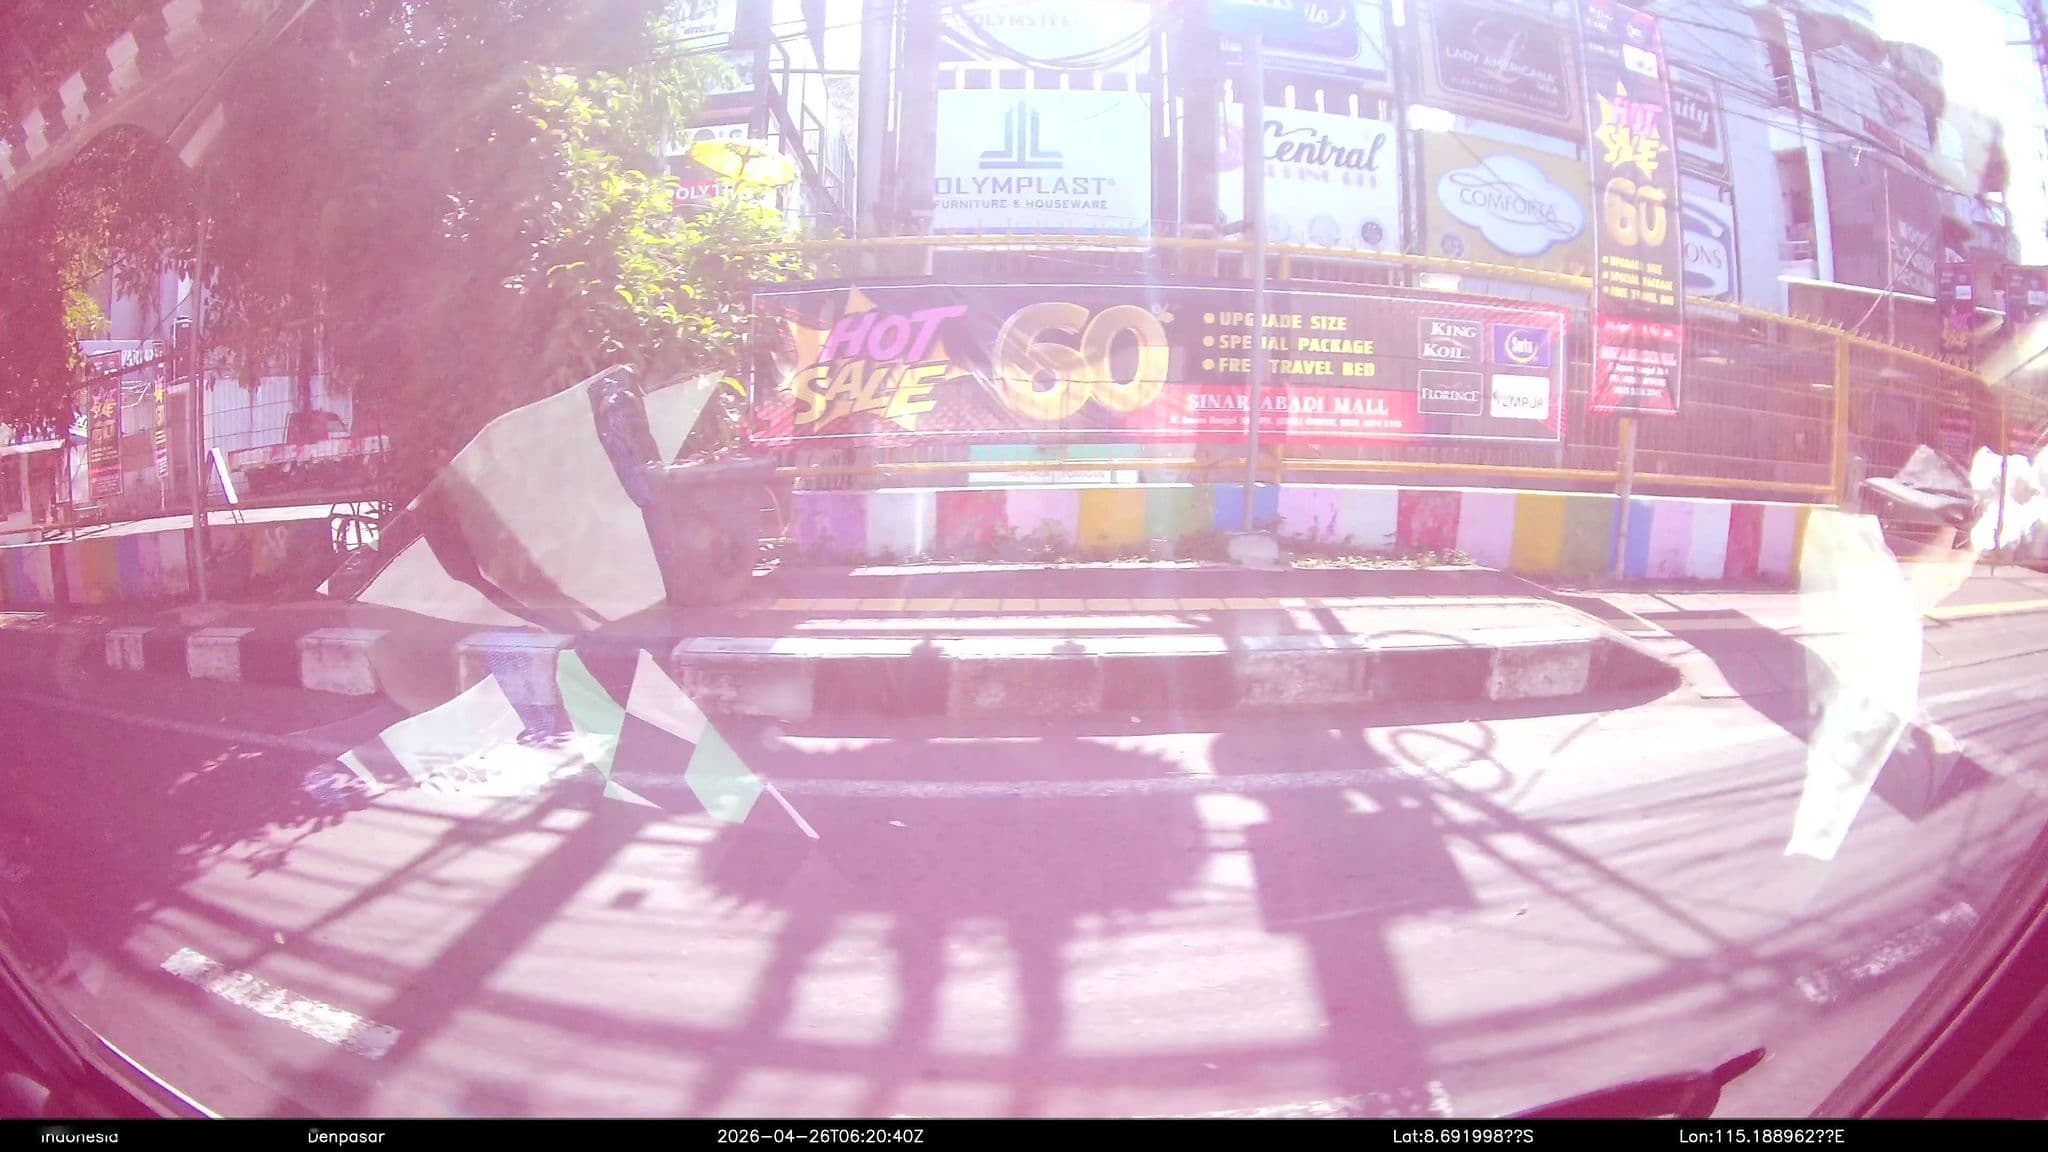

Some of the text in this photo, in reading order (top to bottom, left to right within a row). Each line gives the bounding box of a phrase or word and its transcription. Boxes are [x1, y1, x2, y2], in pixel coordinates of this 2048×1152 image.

[1445, 46, 1479, 63] LADY
[935, 199, 1008, 209] FURNITURE
[1026, 199, 1108, 209] HOUSEWARE
[1310, 315, 1348, 331] SIZE
[1431, 321, 1478, 338] KING
[819, 304, 968, 362] HOT
[1218, 334, 1376, 354] SPEIAL PACKAGE
[1422, 343, 1471, 359] KOIL
[1218, 357, 1376, 377] FRE TRAVEL BED
[792, 358, 951, 426] SALE
[1186, 393, 1389, 416] SINAR ABADI MALL
